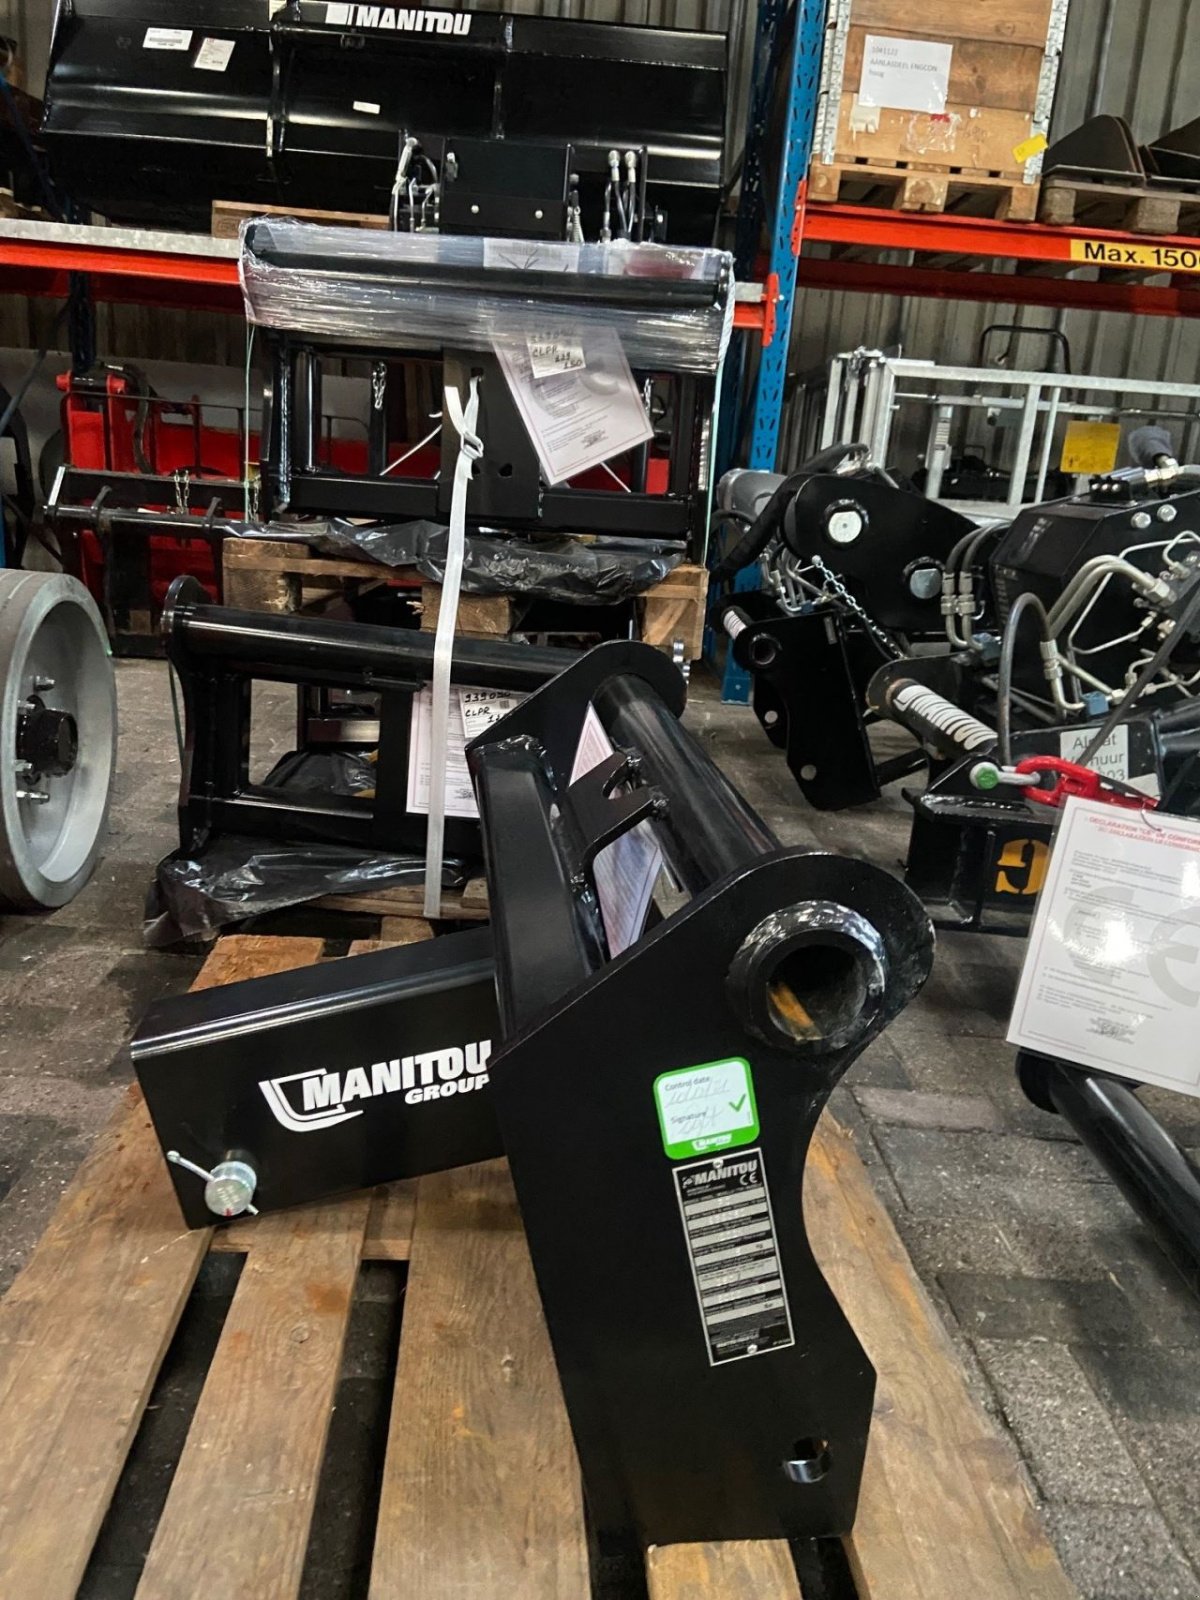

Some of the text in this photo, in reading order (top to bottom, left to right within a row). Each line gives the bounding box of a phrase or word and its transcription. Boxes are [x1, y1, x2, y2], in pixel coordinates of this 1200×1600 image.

[356, 4, 472, 35] MANITOU
[1085, 242, 1200, 269] Max. 150
[465, 706, 492, 717] CLPR
[303, 1039, 492, 1111] MANITOU
[664, 1076, 710, 1091] Control date
[405, 1074, 490, 1104] GROUP
[671, 1111, 707, 1124] Signature
[694, 1159, 758, 1185] MANITOU
[739, 1172, 758, 1185] CE
